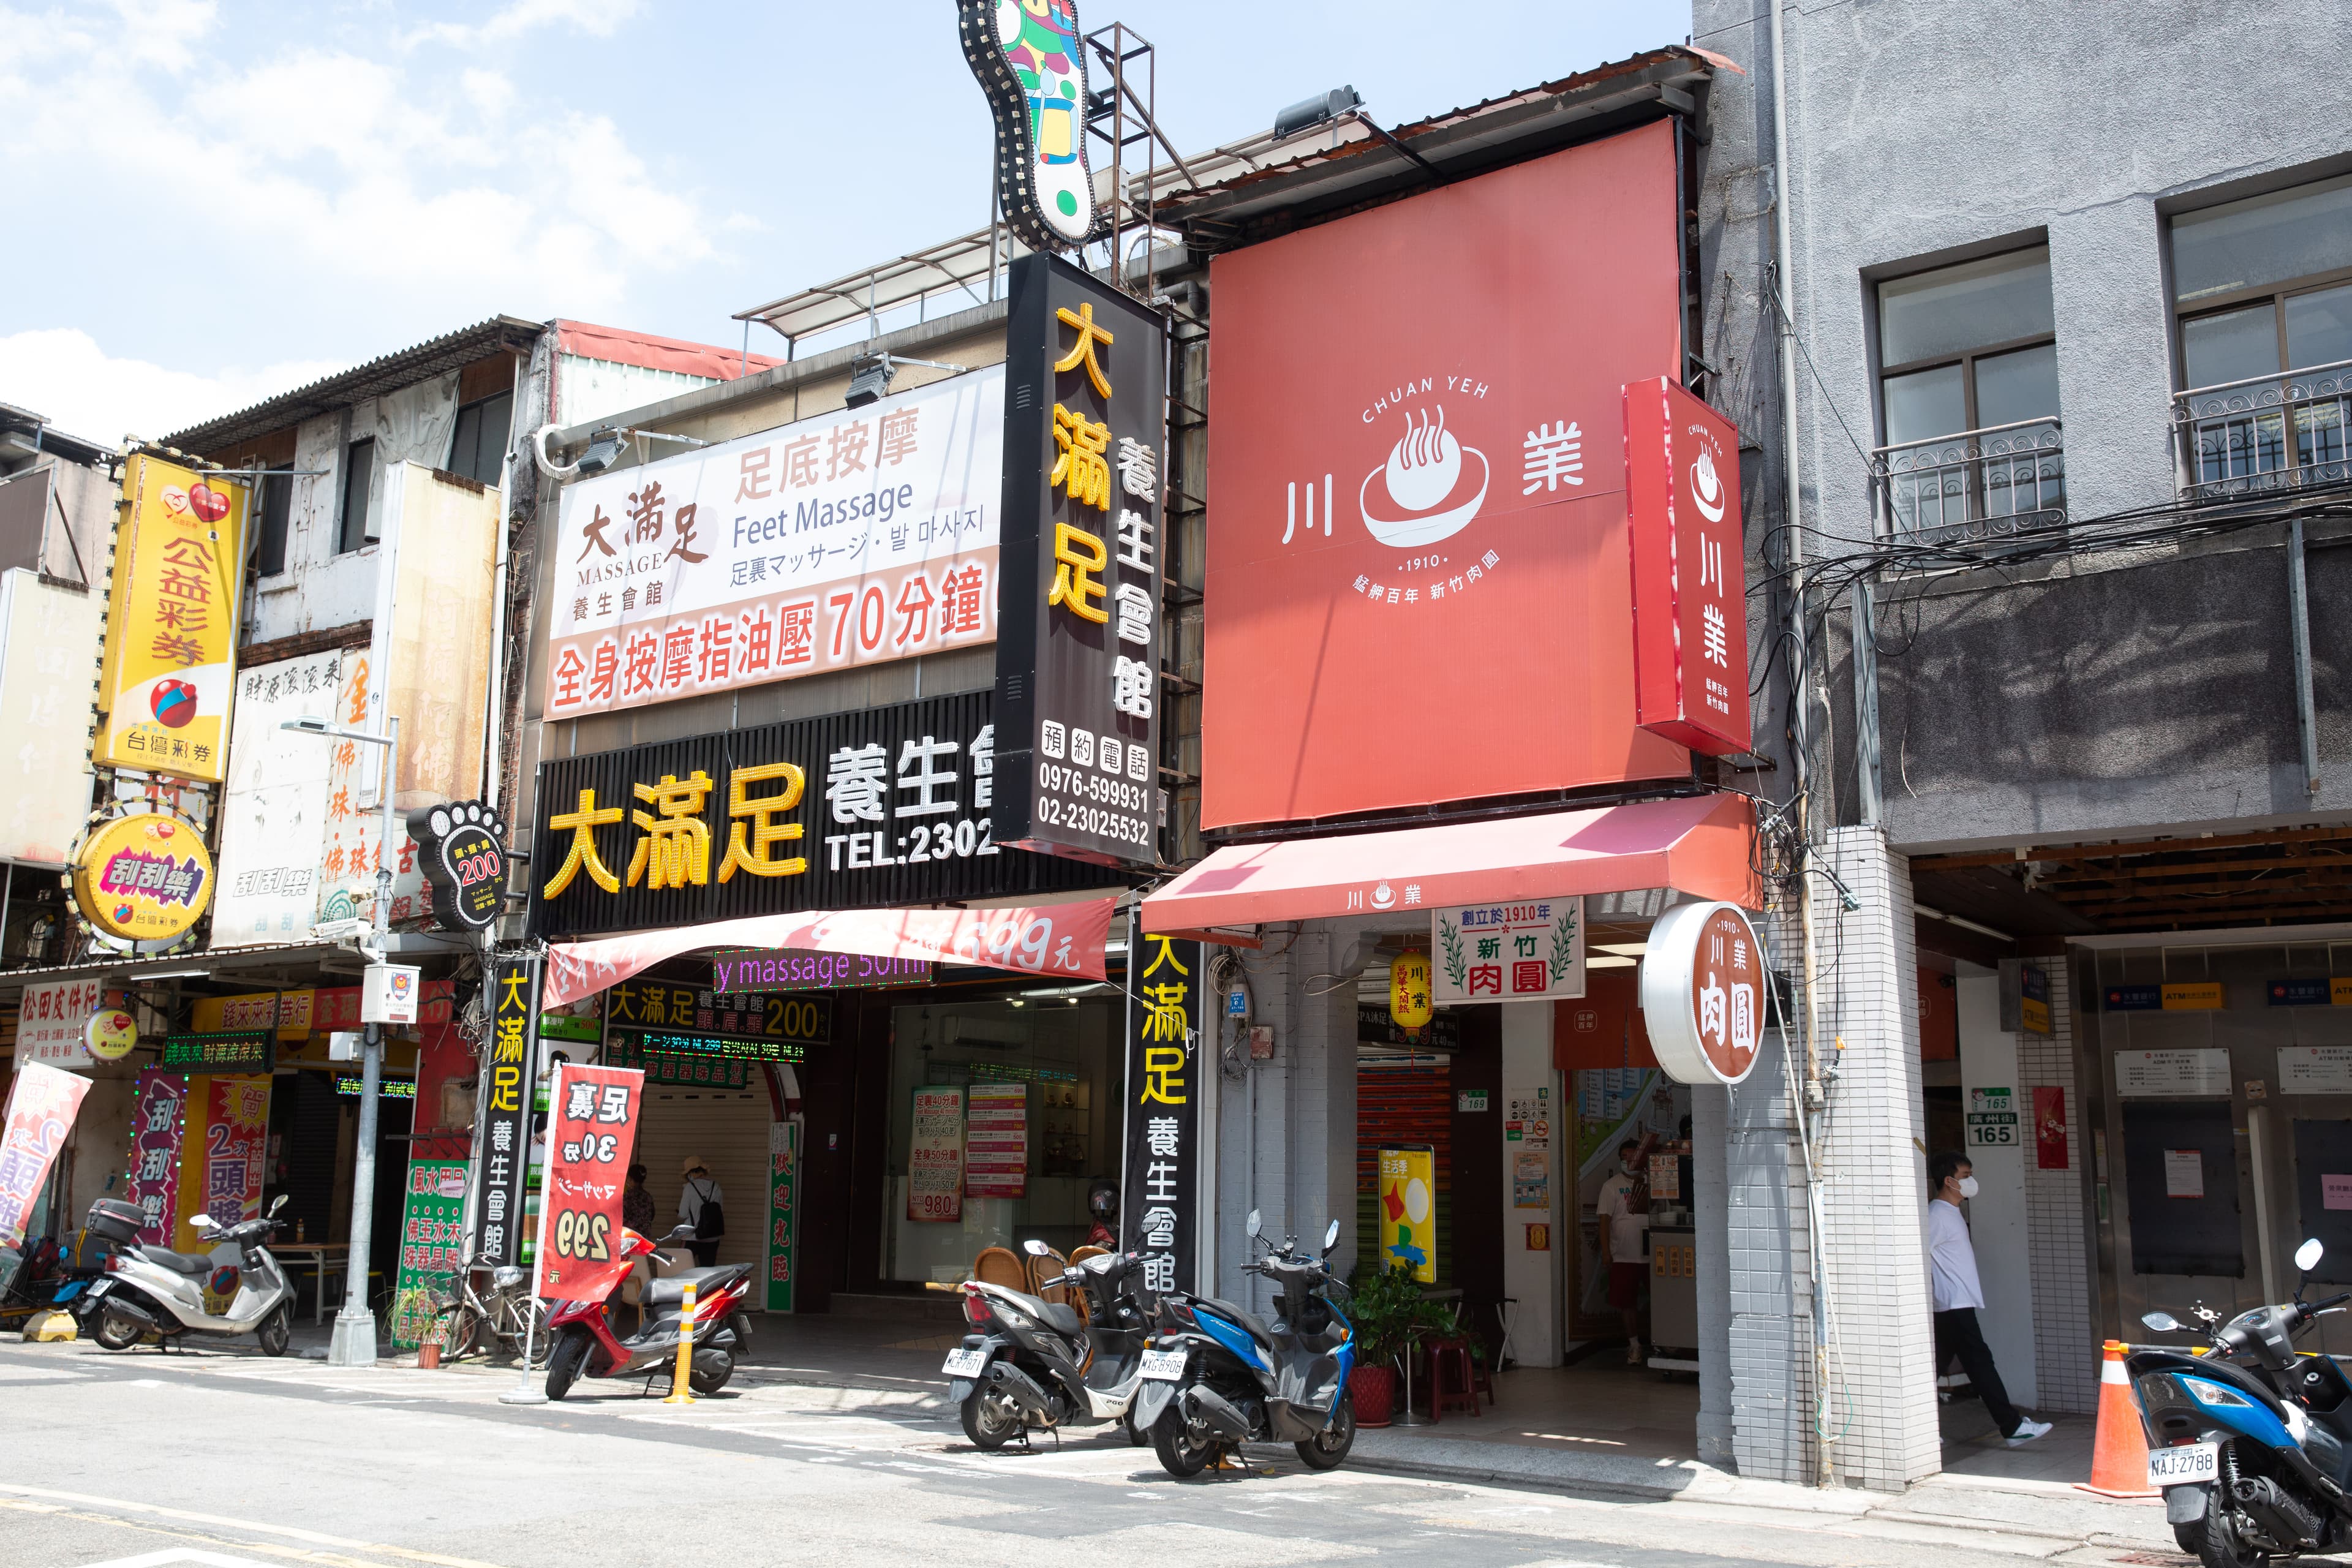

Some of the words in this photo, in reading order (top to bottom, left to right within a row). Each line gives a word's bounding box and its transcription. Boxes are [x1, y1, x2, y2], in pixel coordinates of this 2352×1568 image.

[1362, 377, 1433, 423] CHUAN
[1447, 375, 1489, 399] YEH
[734, 407, 919, 504] 足底按摩
[1048, 302, 1114, 623] 大滿足
[1688, 425, 1708, 436] CHUAN
[1710, 435, 1723, 458] YEH
[1282, 473, 1332, 545] 川
[1523, 420, 1583, 496] 業
[576, 480, 709, 564] 大滿足
[733, 511, 786, 548] Feet
[796, 482, 913, 533] Massage
[576, 552, 663, 587] MASSAGE
[1114, 437, 1157, 719] 養生會館
[1352, 574, 1419, 605] 艋舺百年
[152, 536, 214, 667] 公益彩券
[573, 579, 664, 622] 養生會館
[1700, 532, 1727, 669] 川業
[127, 731, 211, 763] 台灣彩券
[1043, 723, 1147, 778] 預約電話
[1039, 763, 1148, 813] 0976-599931
[543, 761, 807, 900] 大滿足
[1038, 796, 1149, 846] 02-23025532
[108, 858, 194, 898] 刮刮樂
[233, 867, 313, 897] 刮刮樂
[458, 850, 500, 887] 200
[473, 892, 495, 904] MASSAGE
[1461, 903, 1551, 930] 創立於1910年
[1477, 935, 1538, 960] 新竹
[739, 956, 854, 987] massage
[1411, 966, 1427, 1009] 川業
[1468, 960, 1547, 995] 肉圓
[609, 983, 694, 1028] 大滿足
[765, 998, 818, 1039] 200
[1700, 971, 1755, 1054] 肉圓
[490, 968, 529, 1112] 大滿足
[1973, 1126, 2011, 1143] 165
[483, 1120, 513, 1258] 養生會館
[924, 1194, 952, 1214] 980
